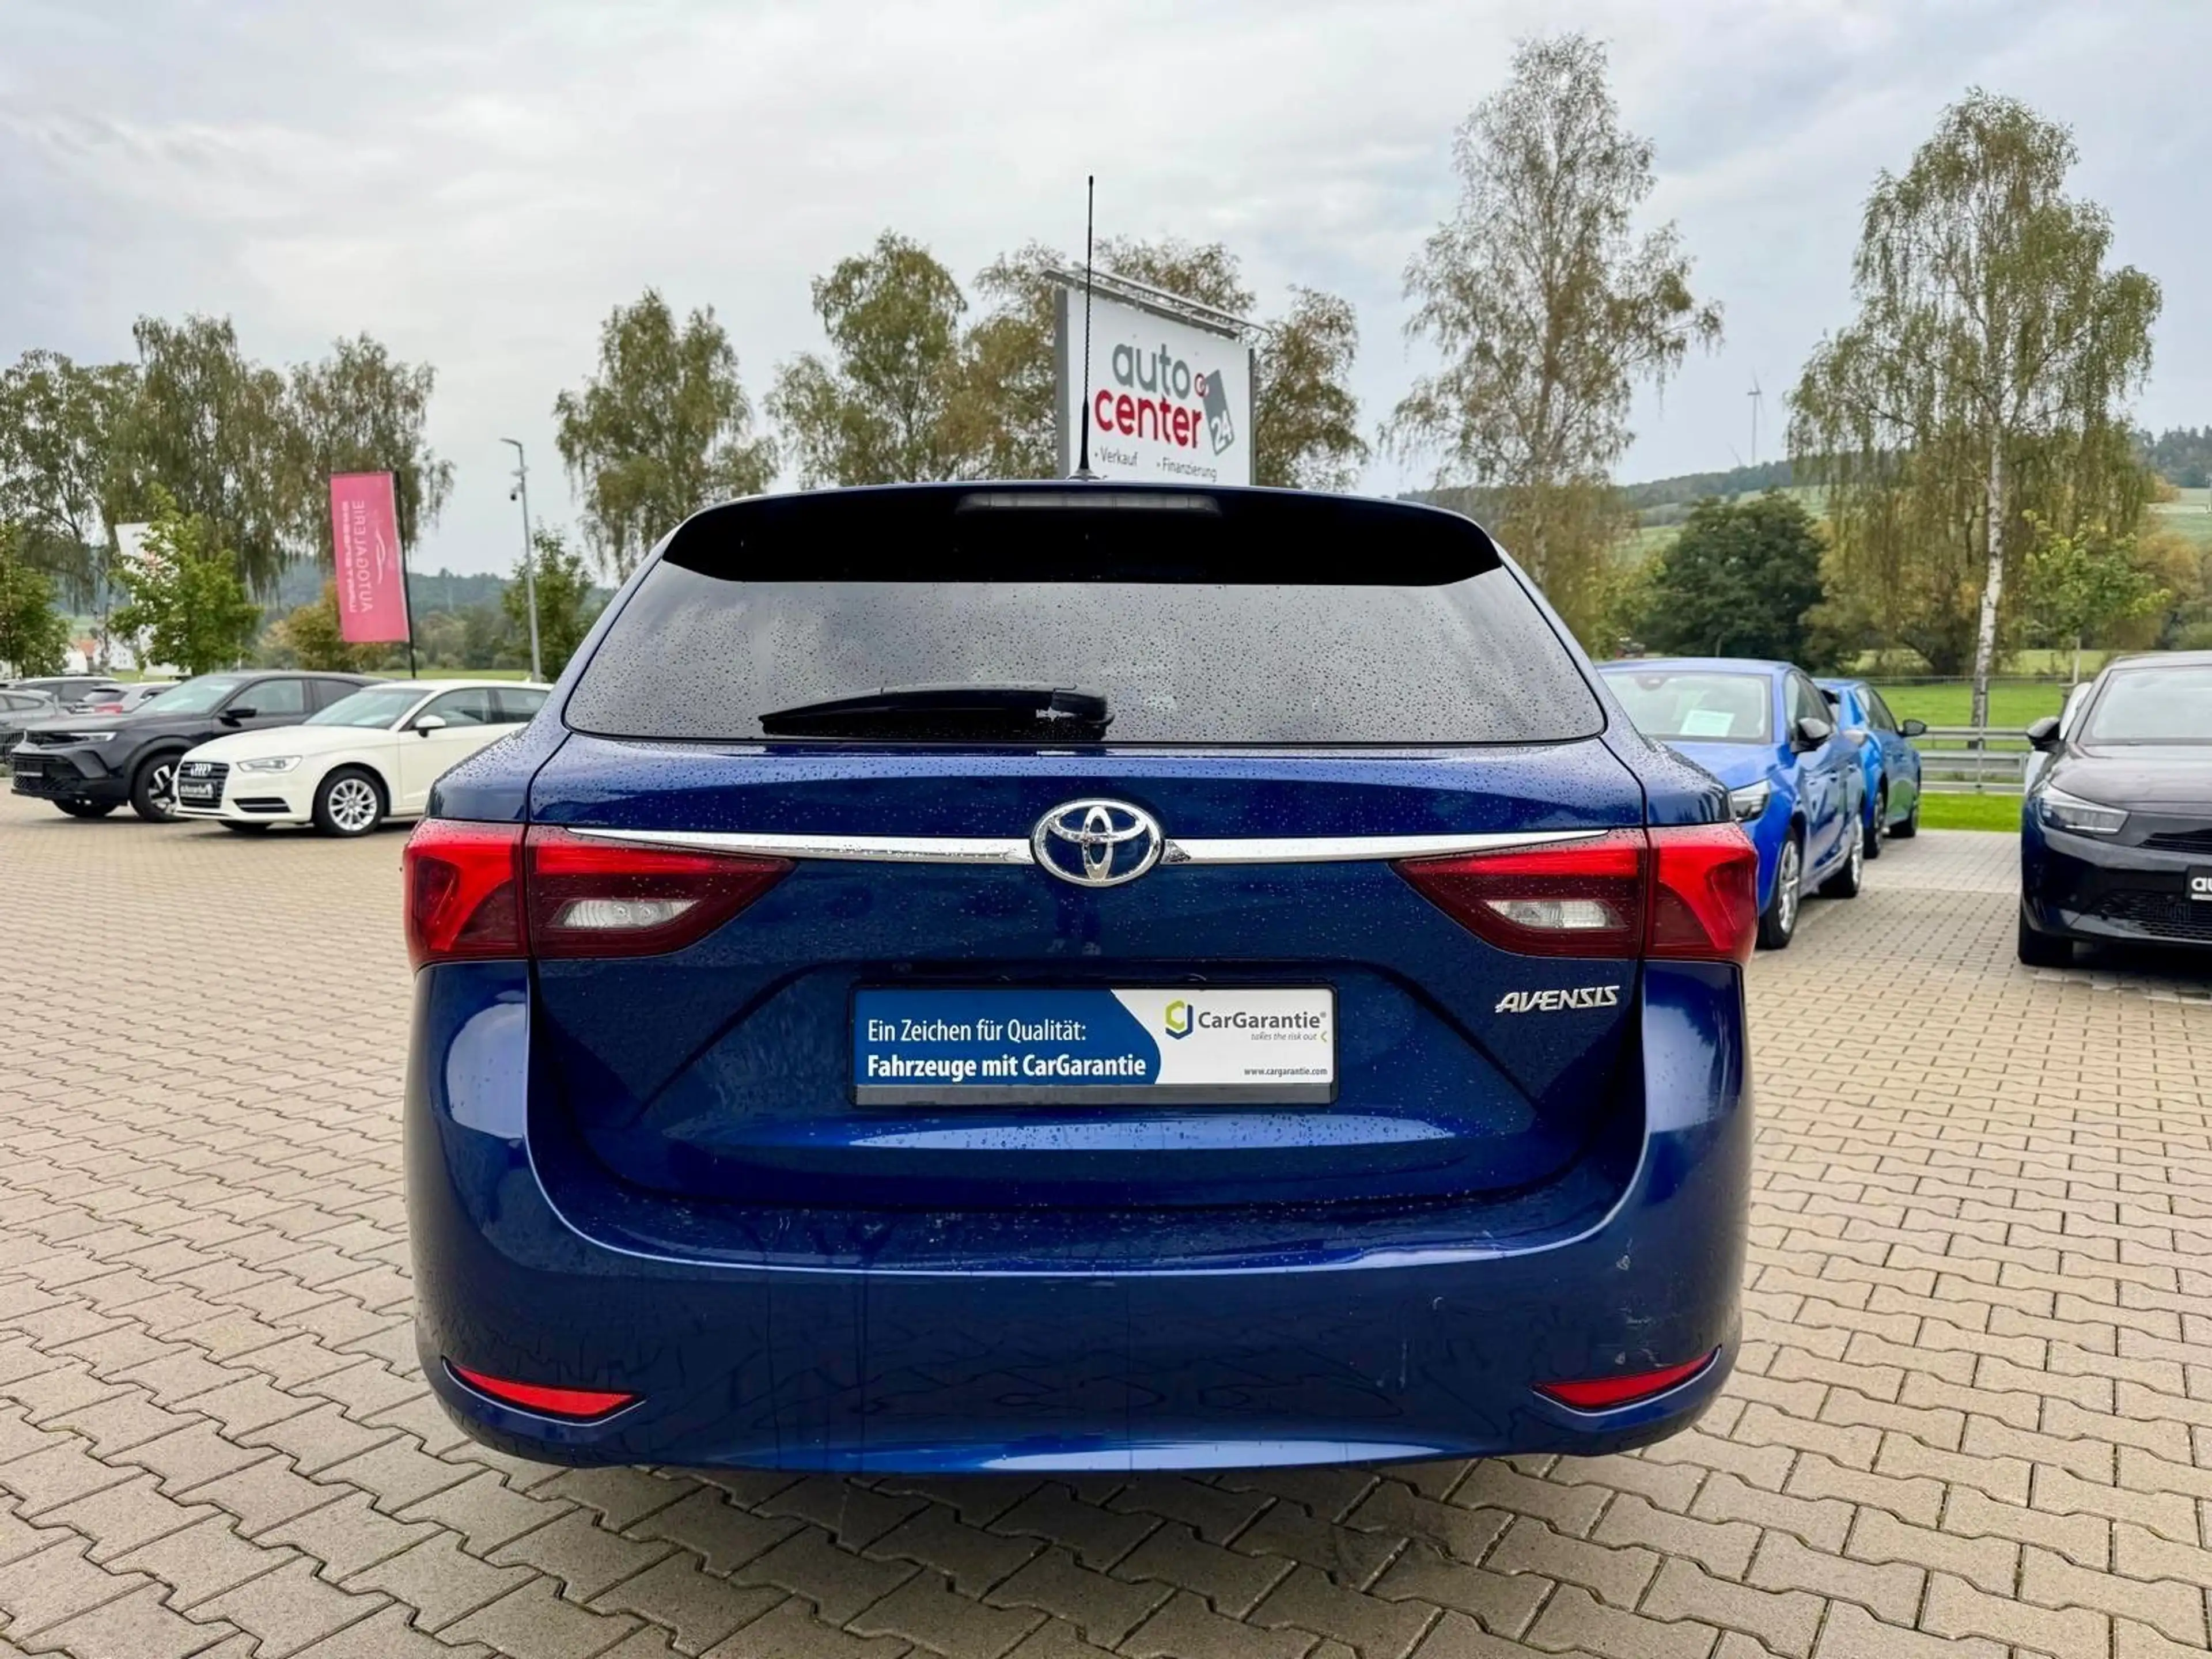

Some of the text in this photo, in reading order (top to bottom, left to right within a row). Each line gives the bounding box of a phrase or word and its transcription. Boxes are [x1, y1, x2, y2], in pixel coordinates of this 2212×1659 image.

[1112, 343, 1191, 400] auto
[1094, 389, 1202, 449] center
[1211, 408, 1233, 452] 24
[1100, 446, 1218, 483] Verkauf Finanzierung
[1495, 985, 1620, 1013] AVENSIS
[868, 1018, 1086, 1043] Ein Zeichen für Qualität:
[1251, 1032, 1272, 1041] takes
[1274, 1032, 1286, 1041] the
[1288, 1032, 1302, 1041] risk
[868, 1054, 1146, 1082] Fahrzeuge mit CarGarantie
[1244, 1068, 1328, 1077] www.cargarantie.com
